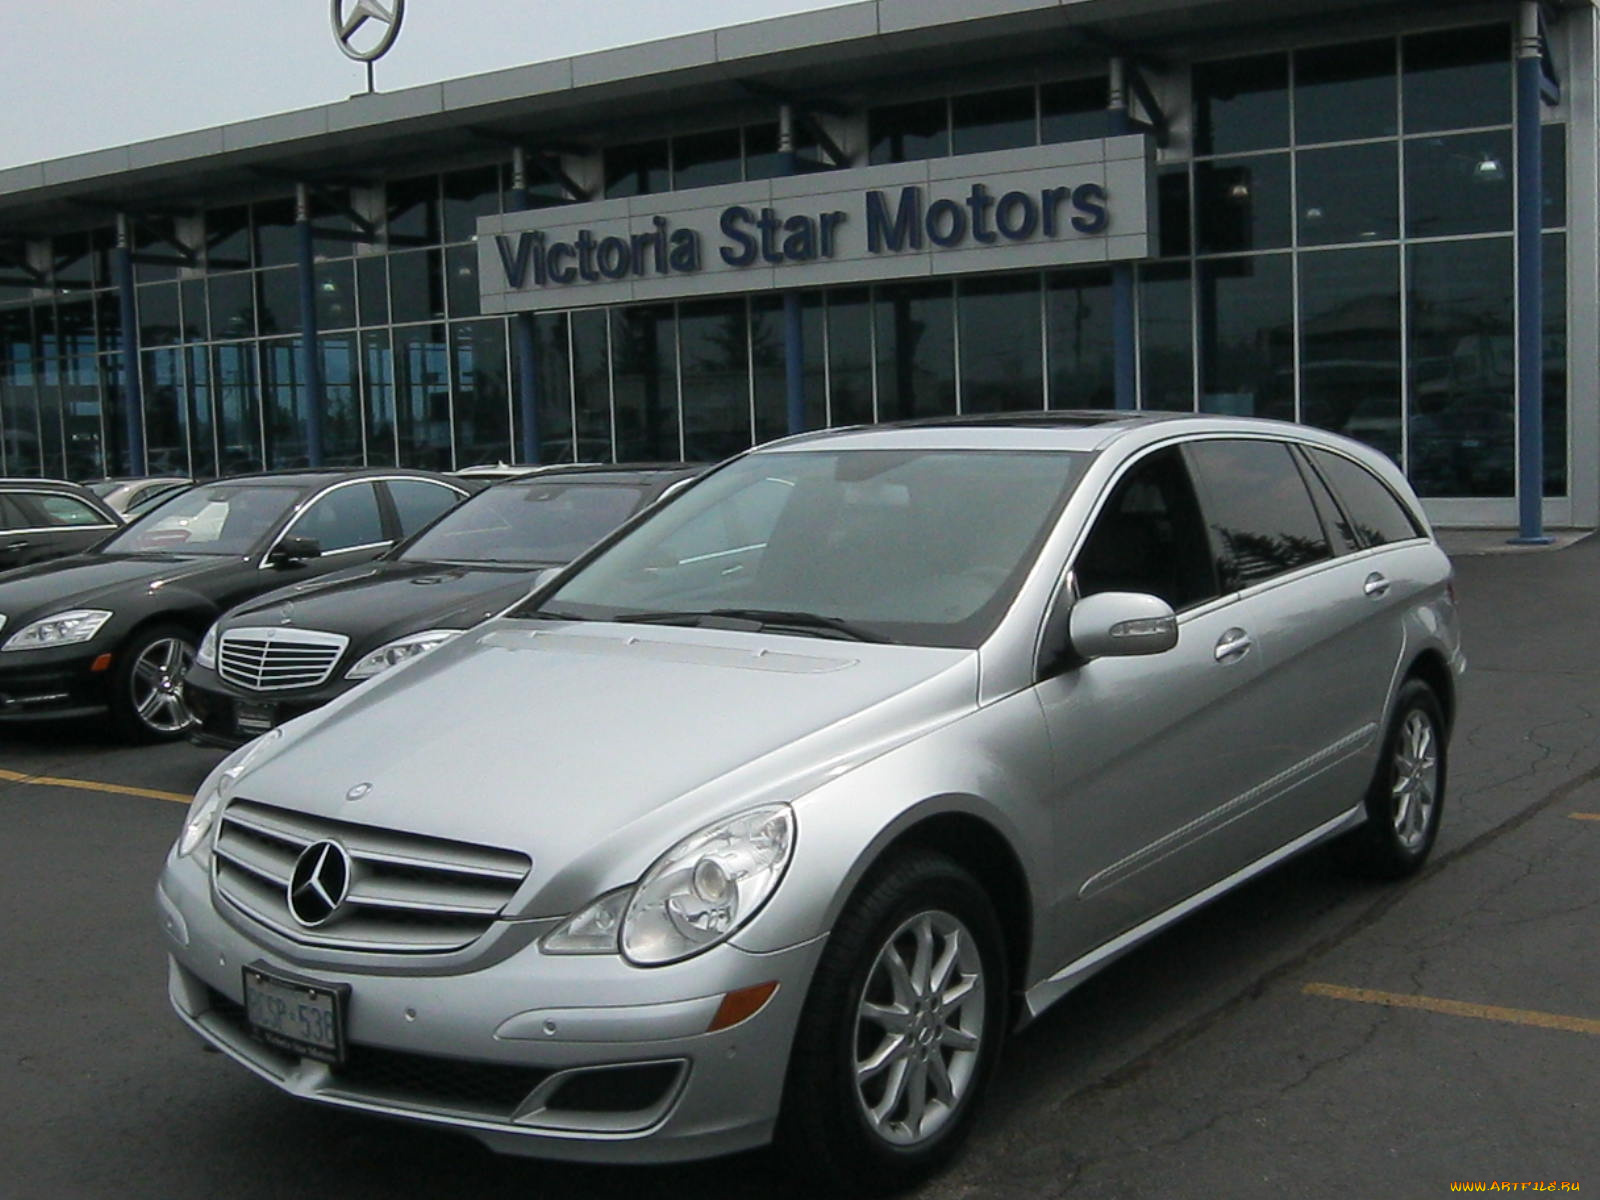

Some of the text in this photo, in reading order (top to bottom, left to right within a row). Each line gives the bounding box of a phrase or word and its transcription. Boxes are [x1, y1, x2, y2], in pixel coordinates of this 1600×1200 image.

[495, 183, 1108, 288] Victoria Star Motors
